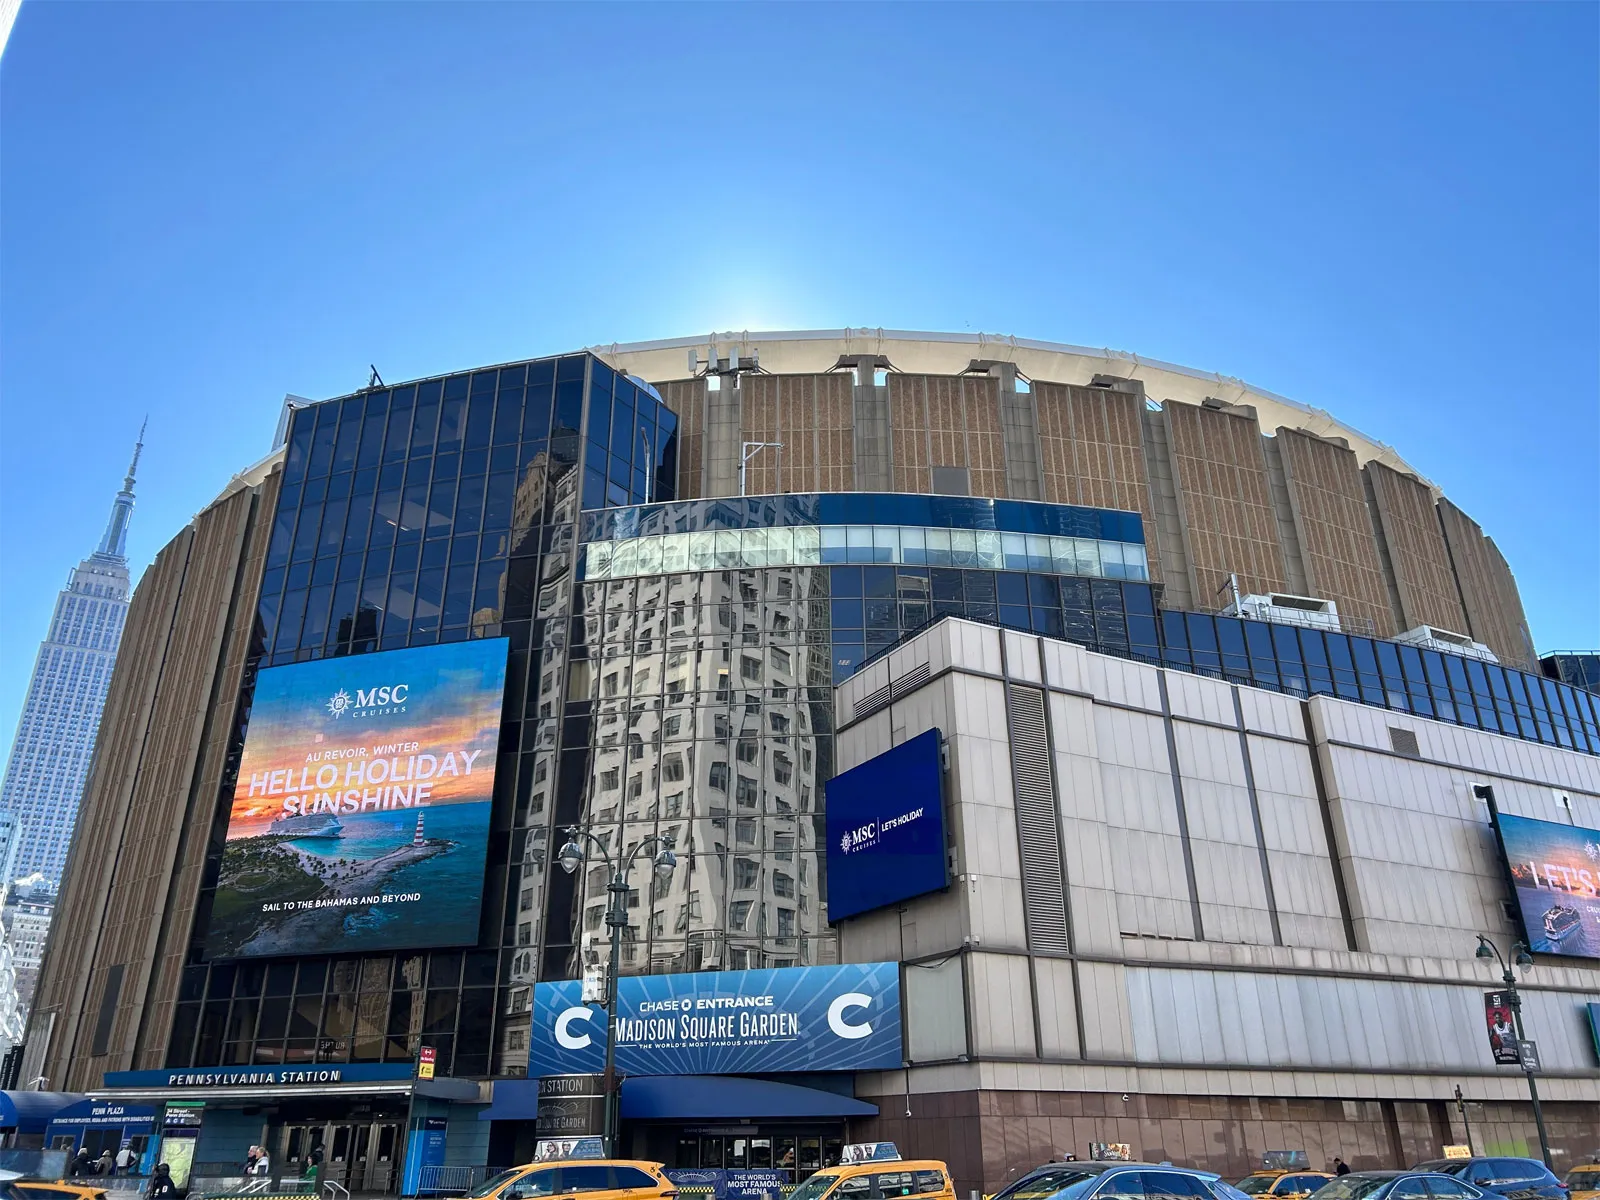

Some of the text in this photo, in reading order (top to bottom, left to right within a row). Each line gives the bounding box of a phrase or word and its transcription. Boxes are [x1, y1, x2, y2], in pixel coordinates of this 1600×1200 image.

[354, 684, 409, 708] MSC
[352, 706, 407, 718] CRUISES
[305, 742, 419, 763] AU REVOIR, WINTER
[248, 749, 482, 797] HELLO HOLIDAY
[281, 782, 434, 818] SUNSHINE
[881, 807, 924, 832] LET'S HOLIDAY
[852, 823, 876, 845] MSC
[852, 839, 876, 853] CRUISES
[1530, 861, 1596, 897] LET'S
[262, 892, 421, 912] SAIL TO THE BAHAMAS AND BEYOND
[640, 995, 774, 1012] CHASE ENTRANCE
[827, 992, 873, 1039] C
[554, 1006, 594, 1050] C
[615, 1017, 676, 1042] MADISON
[680, 1014, 735, 1041] SQUARE
[168, 1070, 340, 1085] PENNSYLVANIA STATION
[547, 1079, 583, 1093] STATION
[92, 1106, 124, 1115] PENN PLAZA
[561, 1116, 586, 1128] GARDEN
